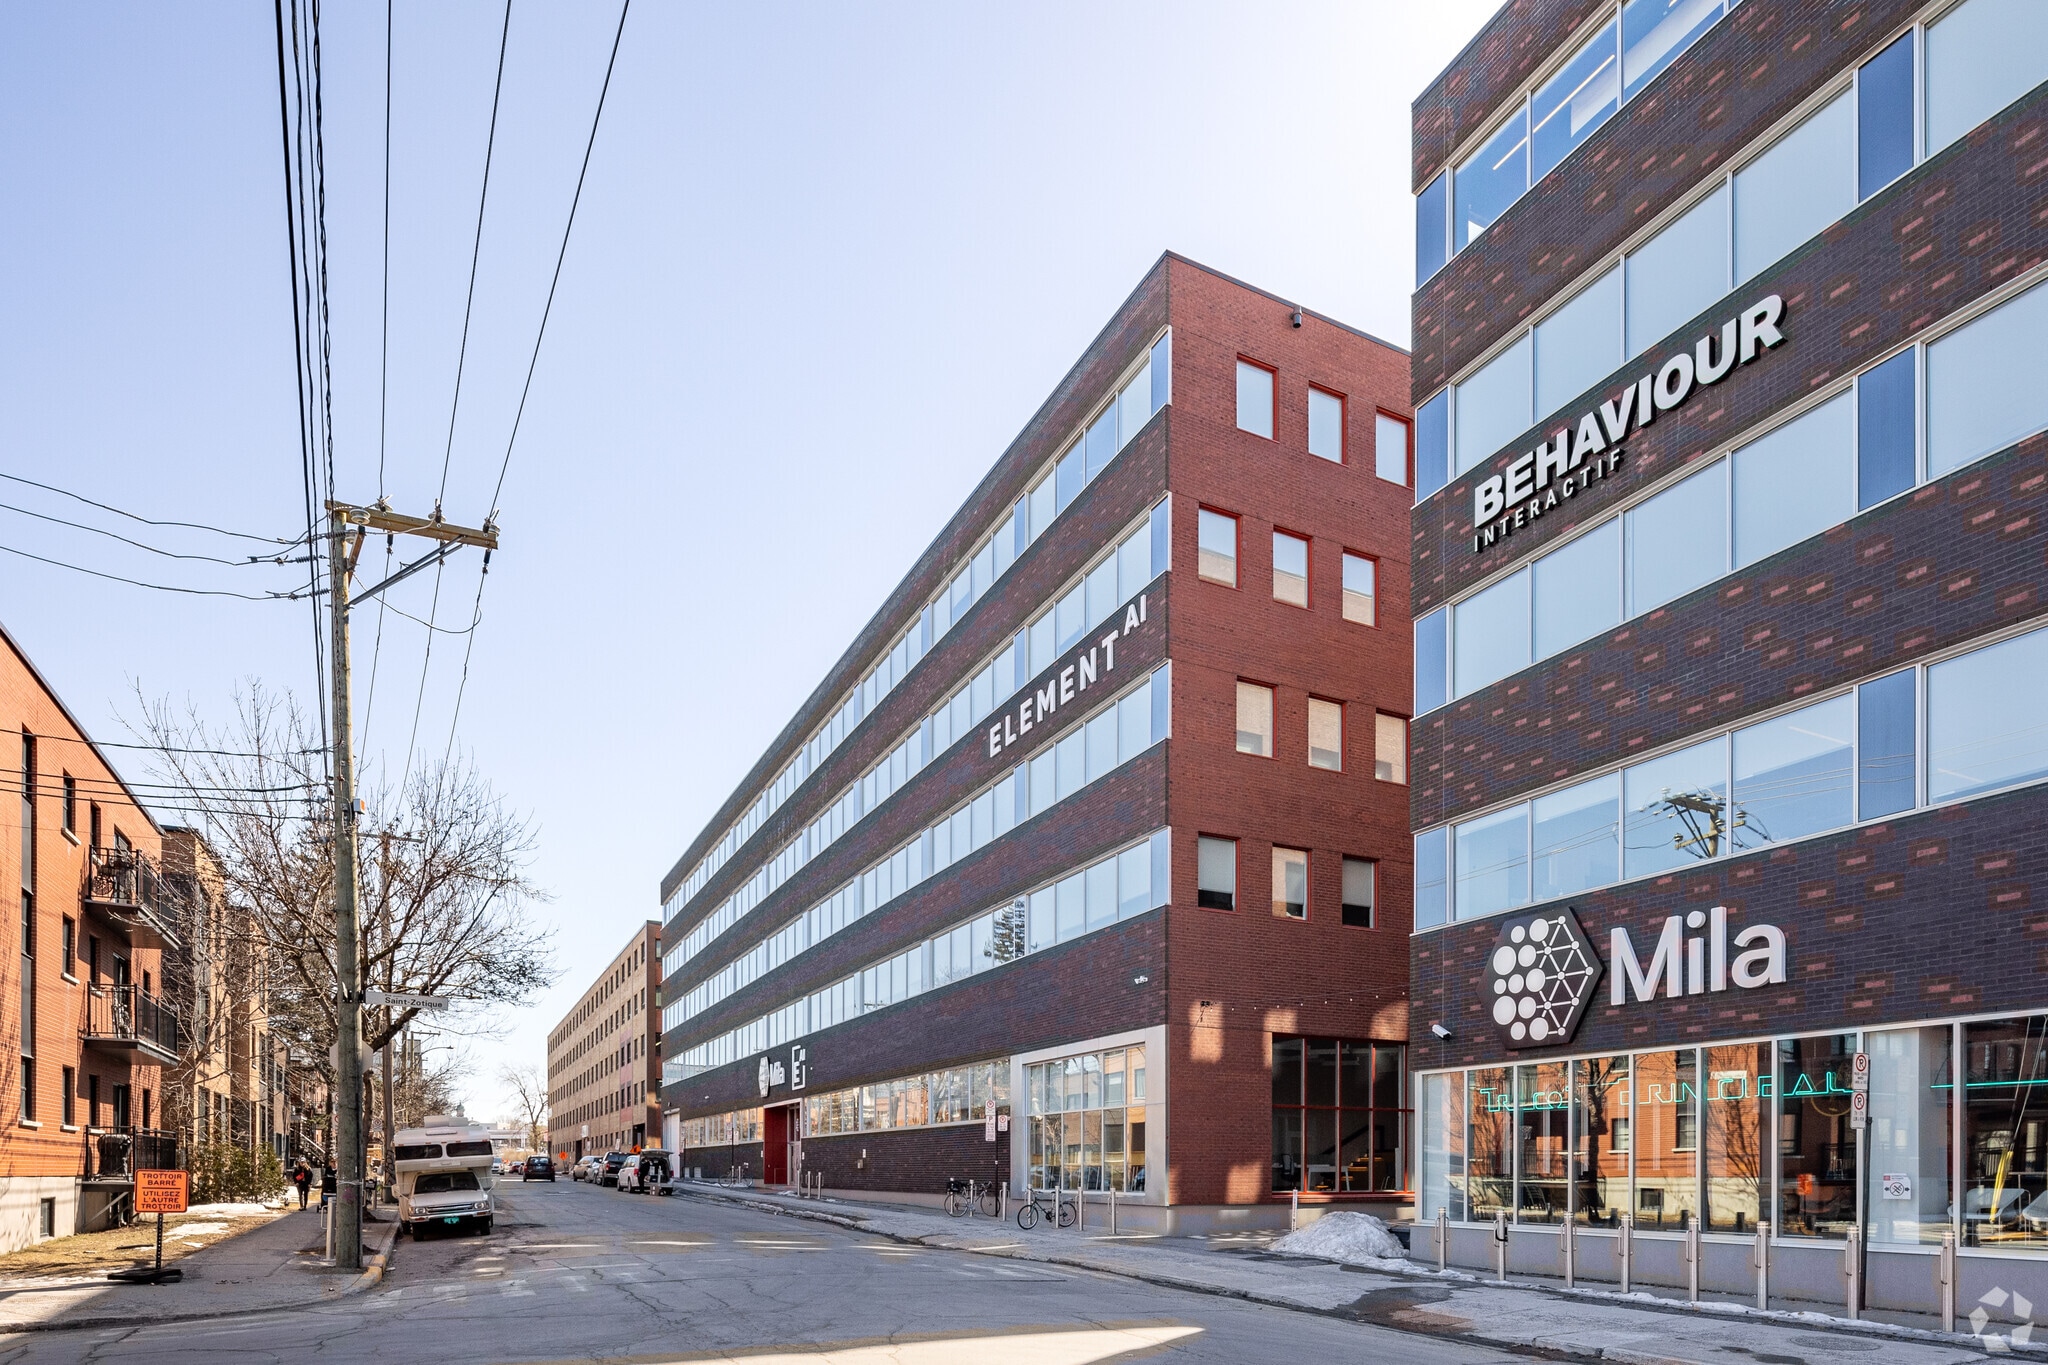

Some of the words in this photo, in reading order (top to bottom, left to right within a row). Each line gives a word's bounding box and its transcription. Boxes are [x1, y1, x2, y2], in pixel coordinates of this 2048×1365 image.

[1475, 294, 1785, 528] BEHAVIOUR
[1474, 448, 1622, 552] INTERACTIF
[990, 630, 1119, 758] ELEMENT
[1124, 594, 1147, 636] AI
[385, 996, 443, 1008] Saint-Zotique
[1611, 906, 1787, 1006] Mila
[770, 1061, 785, 1086] Mila
